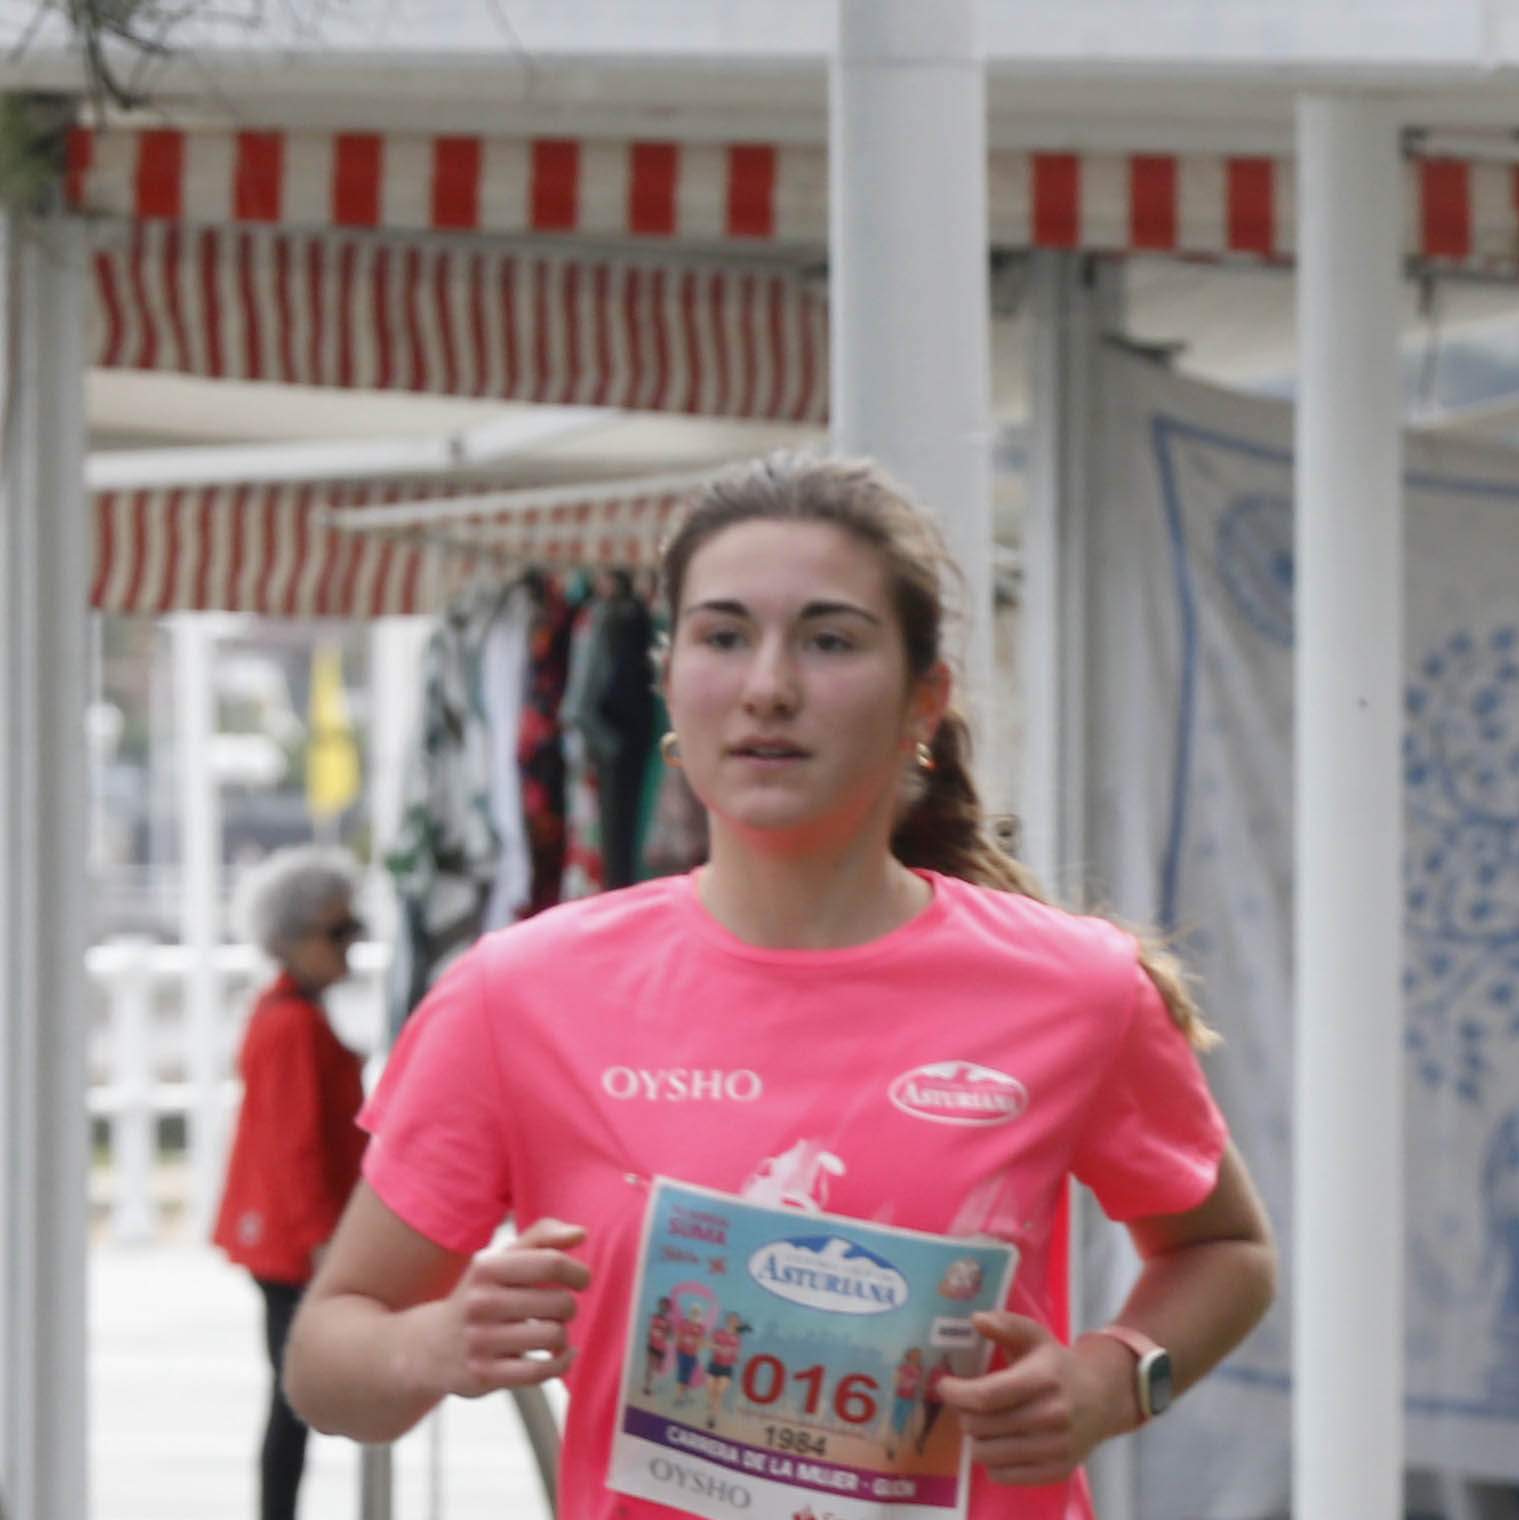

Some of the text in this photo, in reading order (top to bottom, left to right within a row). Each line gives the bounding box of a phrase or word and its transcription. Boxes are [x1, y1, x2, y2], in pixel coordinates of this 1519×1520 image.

[602, 1066, 763, 1101] OYSHO
[759, 1252, 897, 1306] ASTURIANA
[741, 1353, 879, 1425] 016
[765, 1425, 828, 1458] 1984
[649, 1455, 752, 1510] OYSHO
